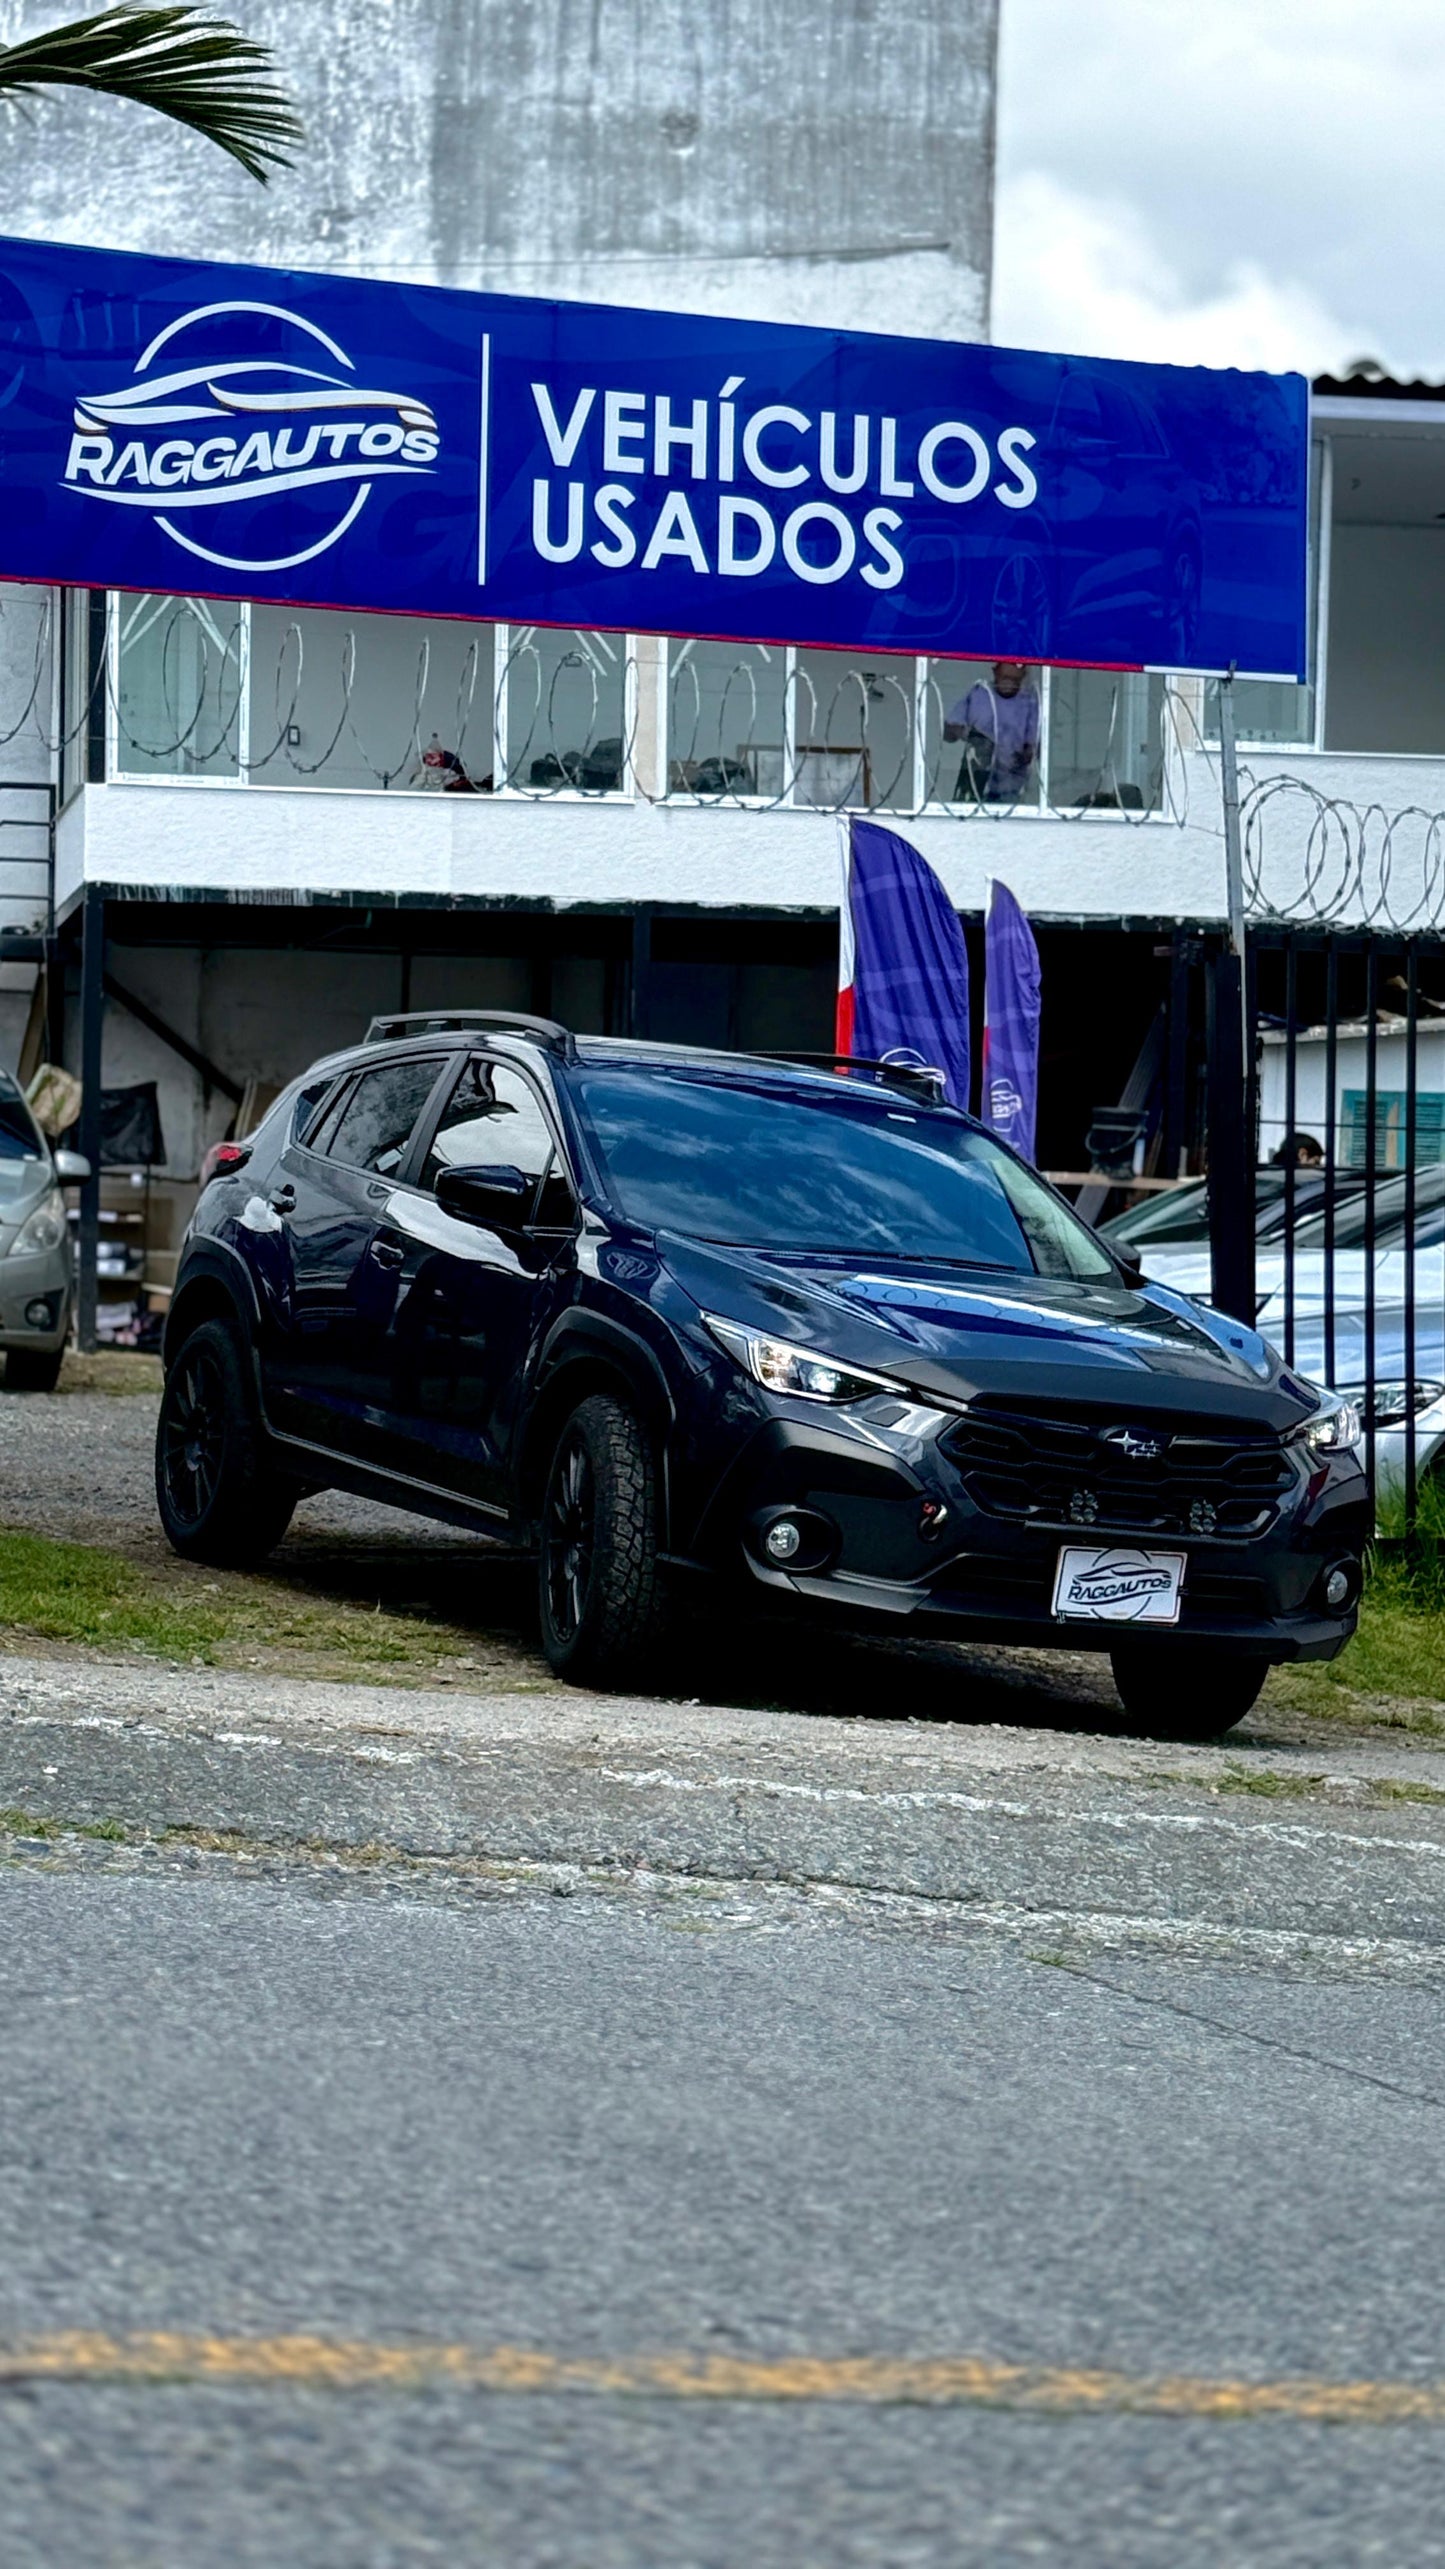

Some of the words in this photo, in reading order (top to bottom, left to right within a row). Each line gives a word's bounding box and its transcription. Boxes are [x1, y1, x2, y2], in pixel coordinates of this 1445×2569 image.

[65, 423, 440, 486] RAGGAUTOS
[530, 376, 1037, 508] VEHÍCULOS
[532, 479, 904, 589] USADOS
[1067, 1578, 1172, 1600] RAGGAUTOS
